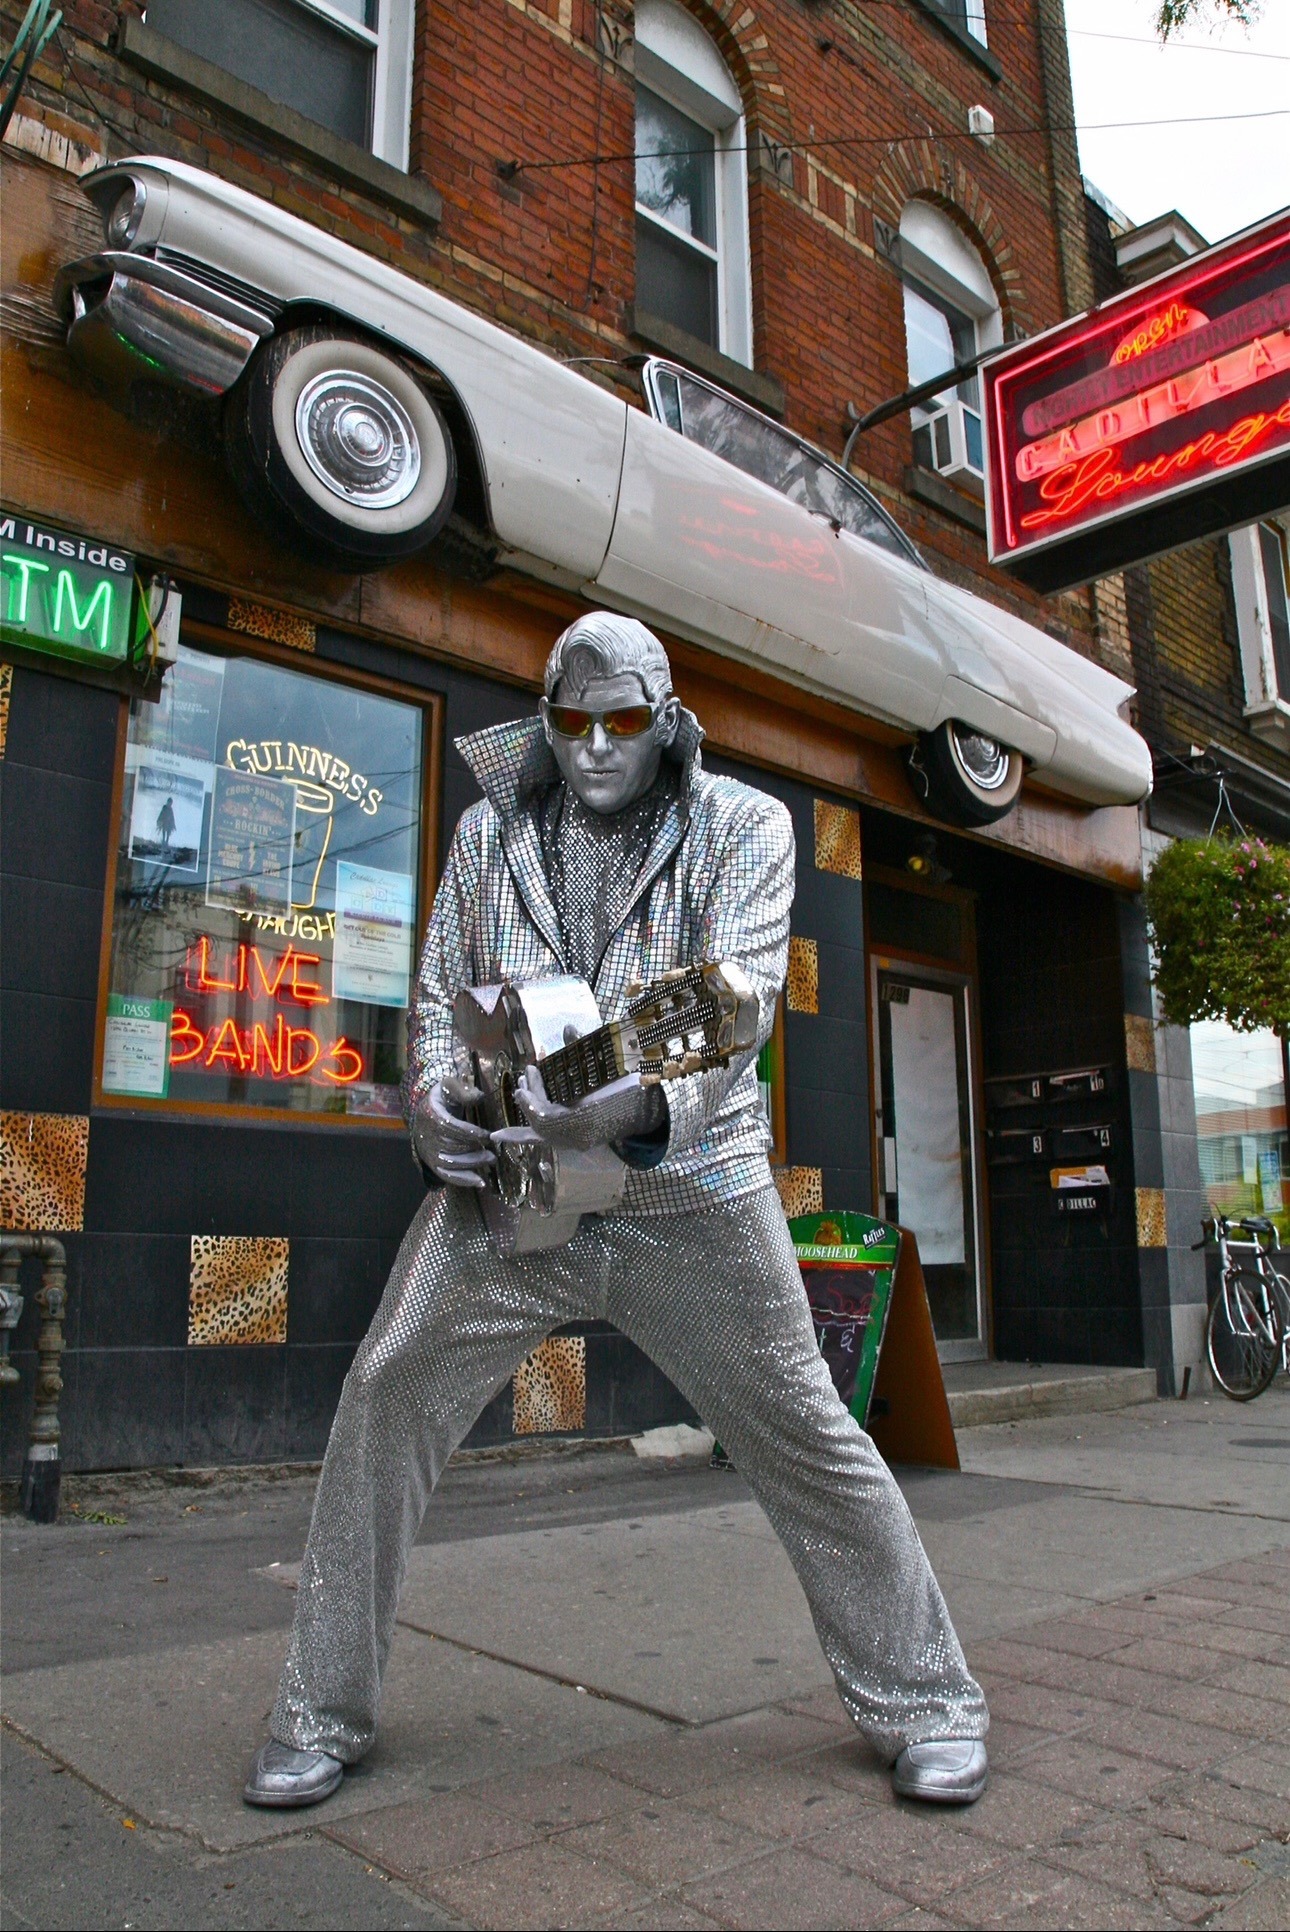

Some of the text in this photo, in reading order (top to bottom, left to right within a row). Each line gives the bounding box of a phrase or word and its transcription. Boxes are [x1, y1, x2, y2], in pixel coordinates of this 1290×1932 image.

[1032, 373, 1107, 427] NIGHTLY
[26, 525, 127, 572] Inside
[226, 739, 383, 816] GUINNESS
[200, 934, 330, 1004] LIVE
[122, 1003, 151, 1018] PASS
[169, 1012, 363, 1082] BANDS
